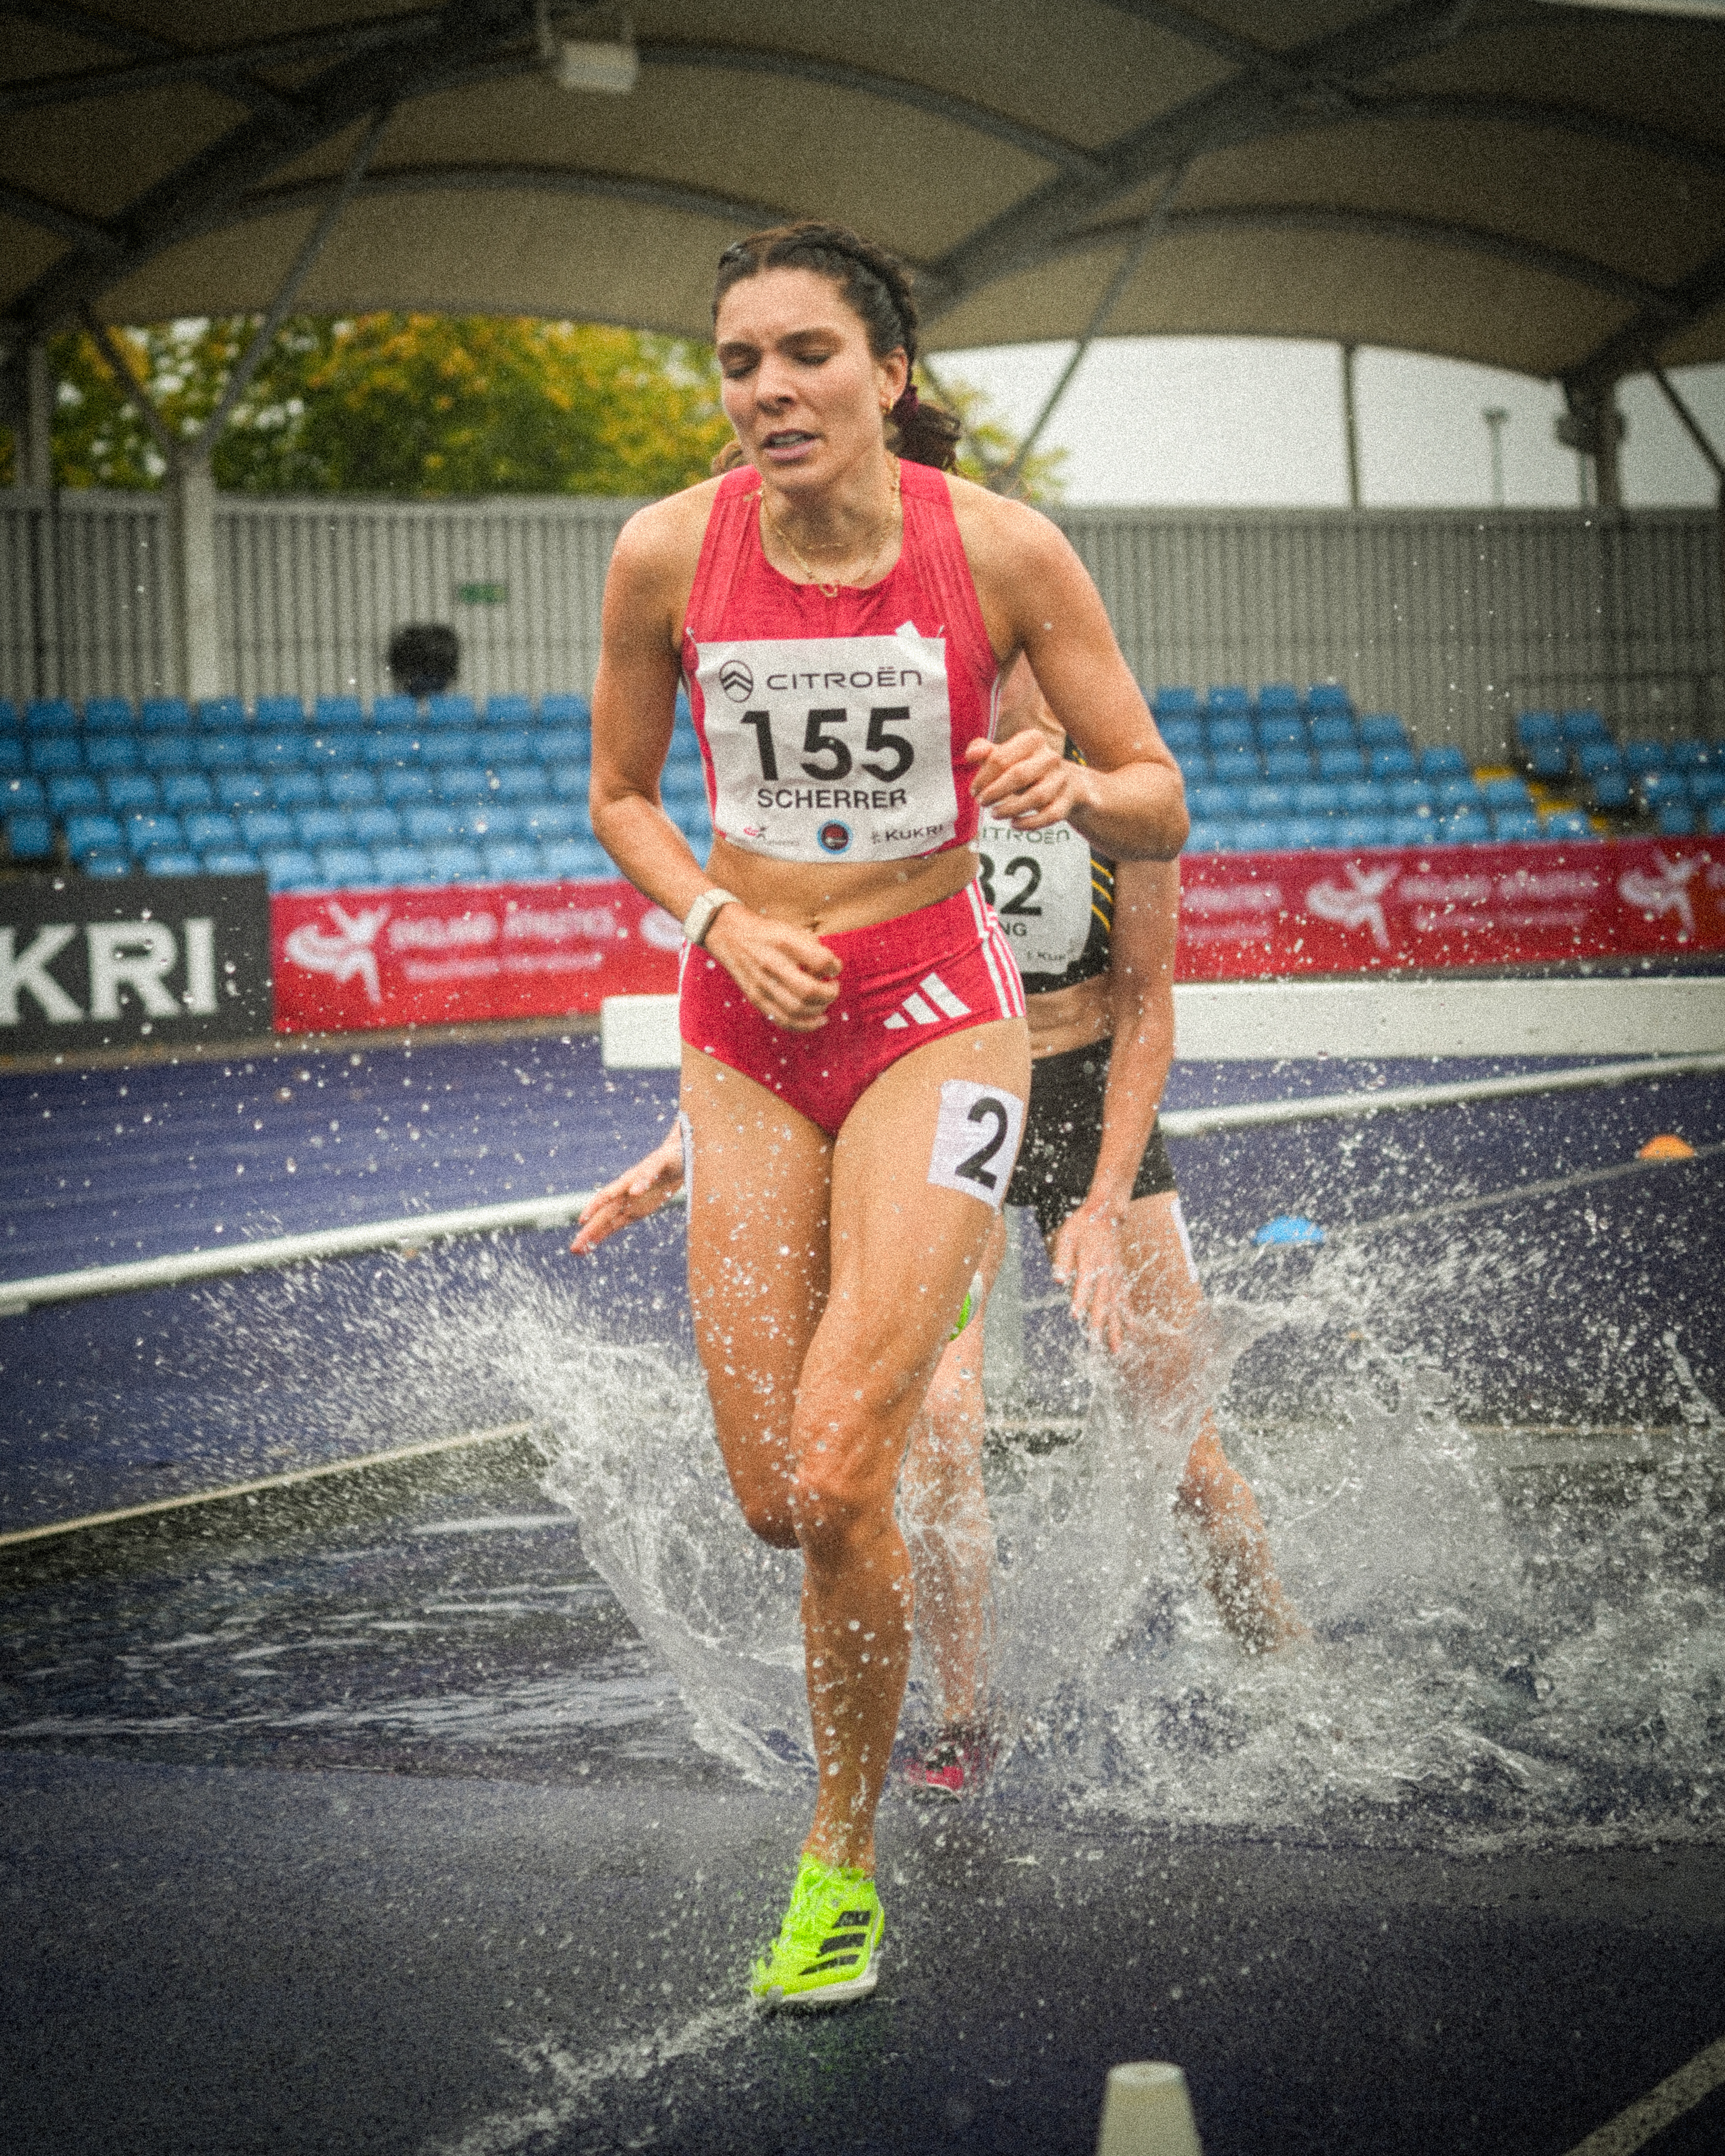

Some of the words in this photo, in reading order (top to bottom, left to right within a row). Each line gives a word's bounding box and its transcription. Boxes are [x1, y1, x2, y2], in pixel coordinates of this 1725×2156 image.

[741, 707, 915, 782] 155
[757, 788, 907, 809] SCHERRER
[885, 824, 944, 841] KUKRI
[982, 827, 1070, 844] ITROËN
[998, 921, 1027, 937] NG
[955, 1097, 1008, 1189] 2
